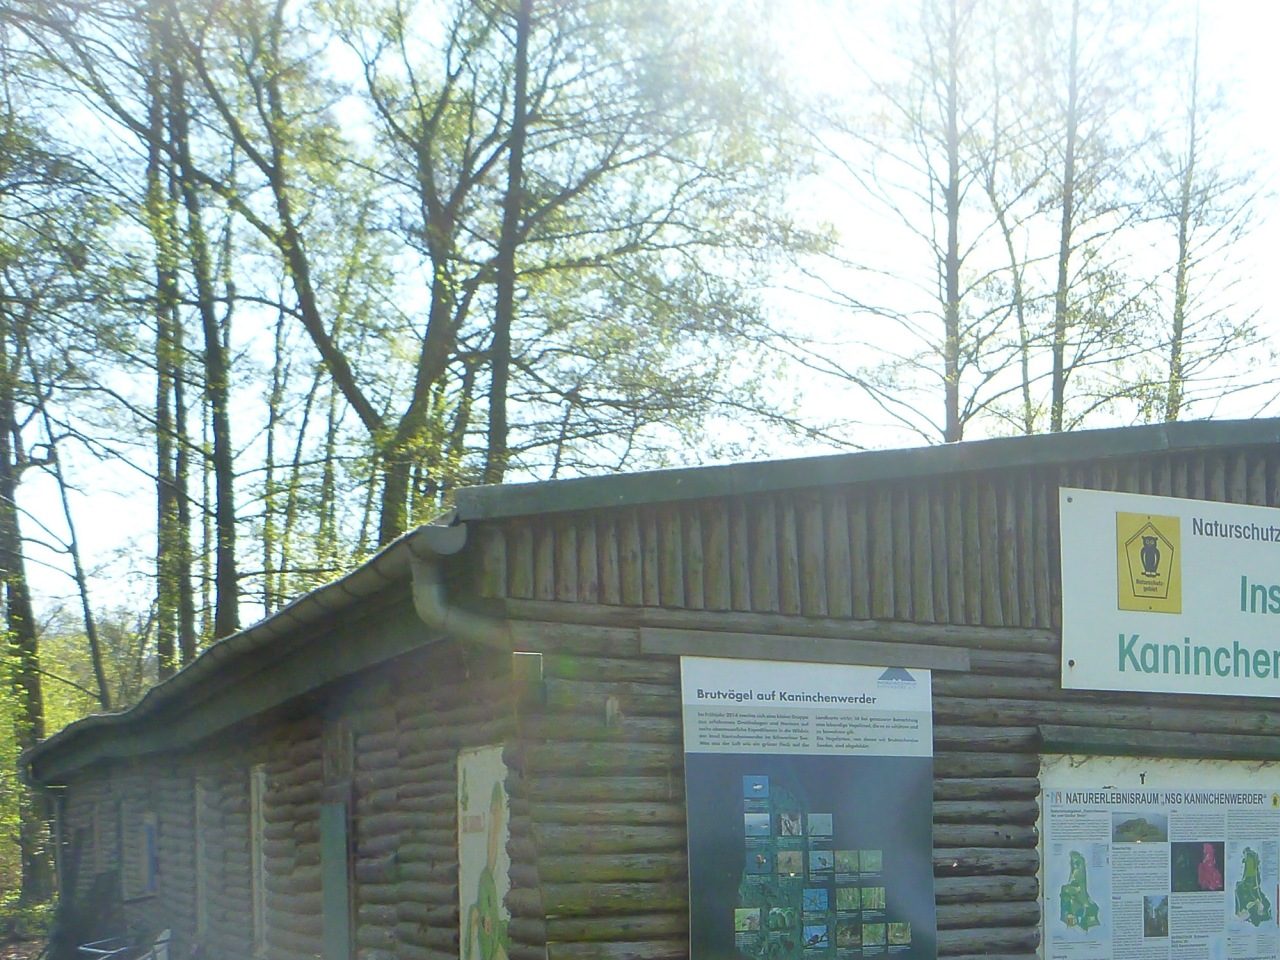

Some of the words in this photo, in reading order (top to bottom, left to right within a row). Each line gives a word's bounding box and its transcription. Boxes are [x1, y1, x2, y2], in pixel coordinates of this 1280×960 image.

[697, 688, 753, 703] Brutvögel
[757, 690, 776, 701] auf
[779, 691, 877, 704] Kaninchenwerder
[1066, 792, 1159, 804] NATURERLEBNISRAUM
